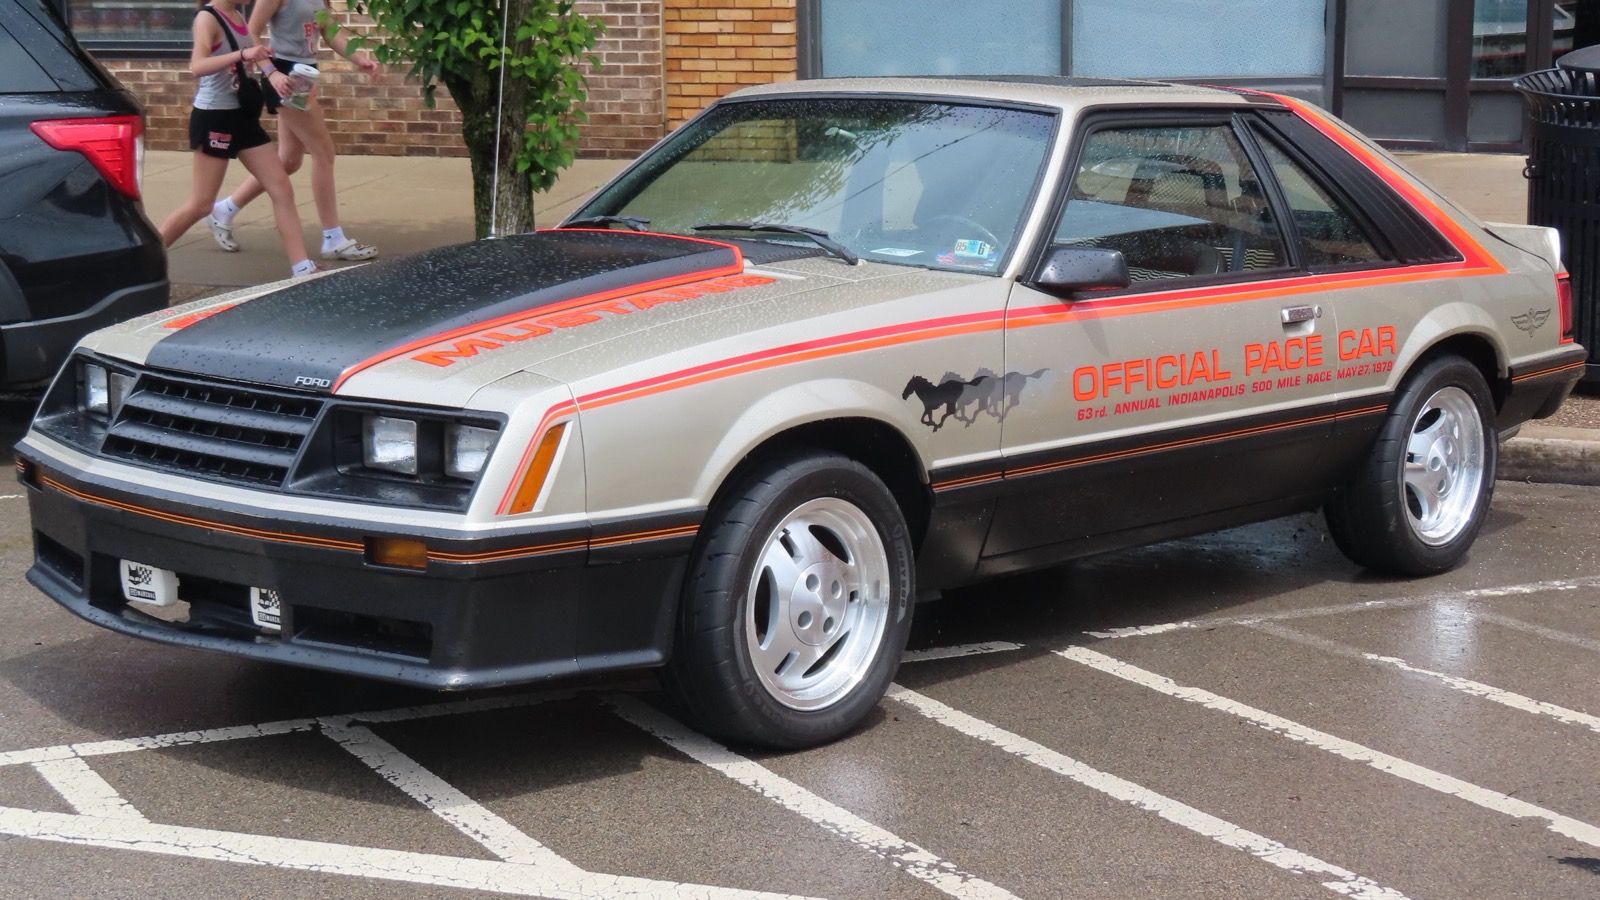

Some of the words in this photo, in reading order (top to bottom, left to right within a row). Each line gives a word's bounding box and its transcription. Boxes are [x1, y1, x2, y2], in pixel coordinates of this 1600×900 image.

[978, 243, 985, 255] 6
[410, 274, 776, 368] MUSTANG
[294, 376, 331, 388] FORD
[1072, 349, 1231, 401] OFFICIAL
[1244, 335, 1323, 377] PACE
[1337, 325, 1396, 361] CAR
[1077, 406, 1108, 421] 63rd.
[1114, 397, 1161, 415] ANNUAL
[1168, 383, 1246, 406] INDIANAPOLIS
[1252, 380, 1273, 393] 500
[1277, 375, 1301, 389] MILE
[1306, 370, 1332, 384] RACE
